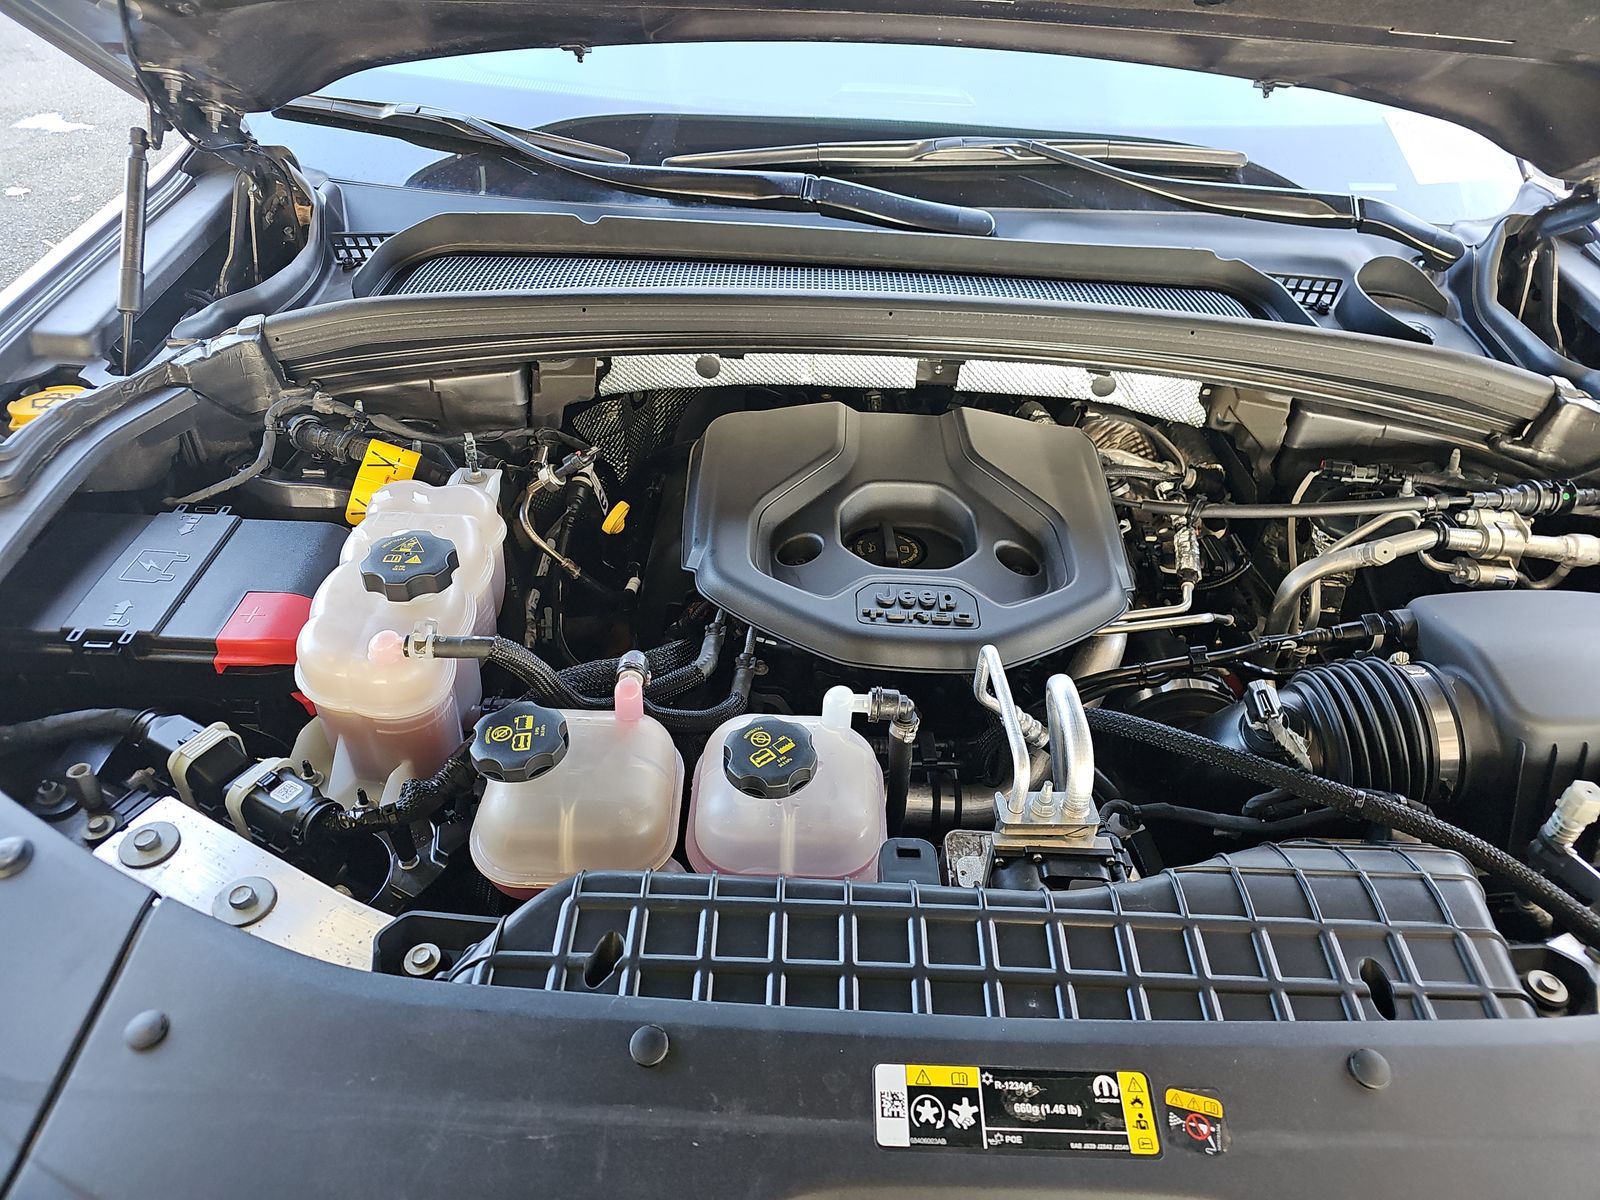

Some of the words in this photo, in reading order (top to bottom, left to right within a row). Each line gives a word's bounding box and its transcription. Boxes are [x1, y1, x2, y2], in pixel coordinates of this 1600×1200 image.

[876, 584, 957, 611] Jeep
[862, 608, 974, 626] TURBO
[1013, 1103, 1040, 1115] 660g
[1041, 1104, 1066, 1116] (1.46
[1067, 1105, 1082, 1117] lb)
[1005, 1135, 1023, 1144] POE
